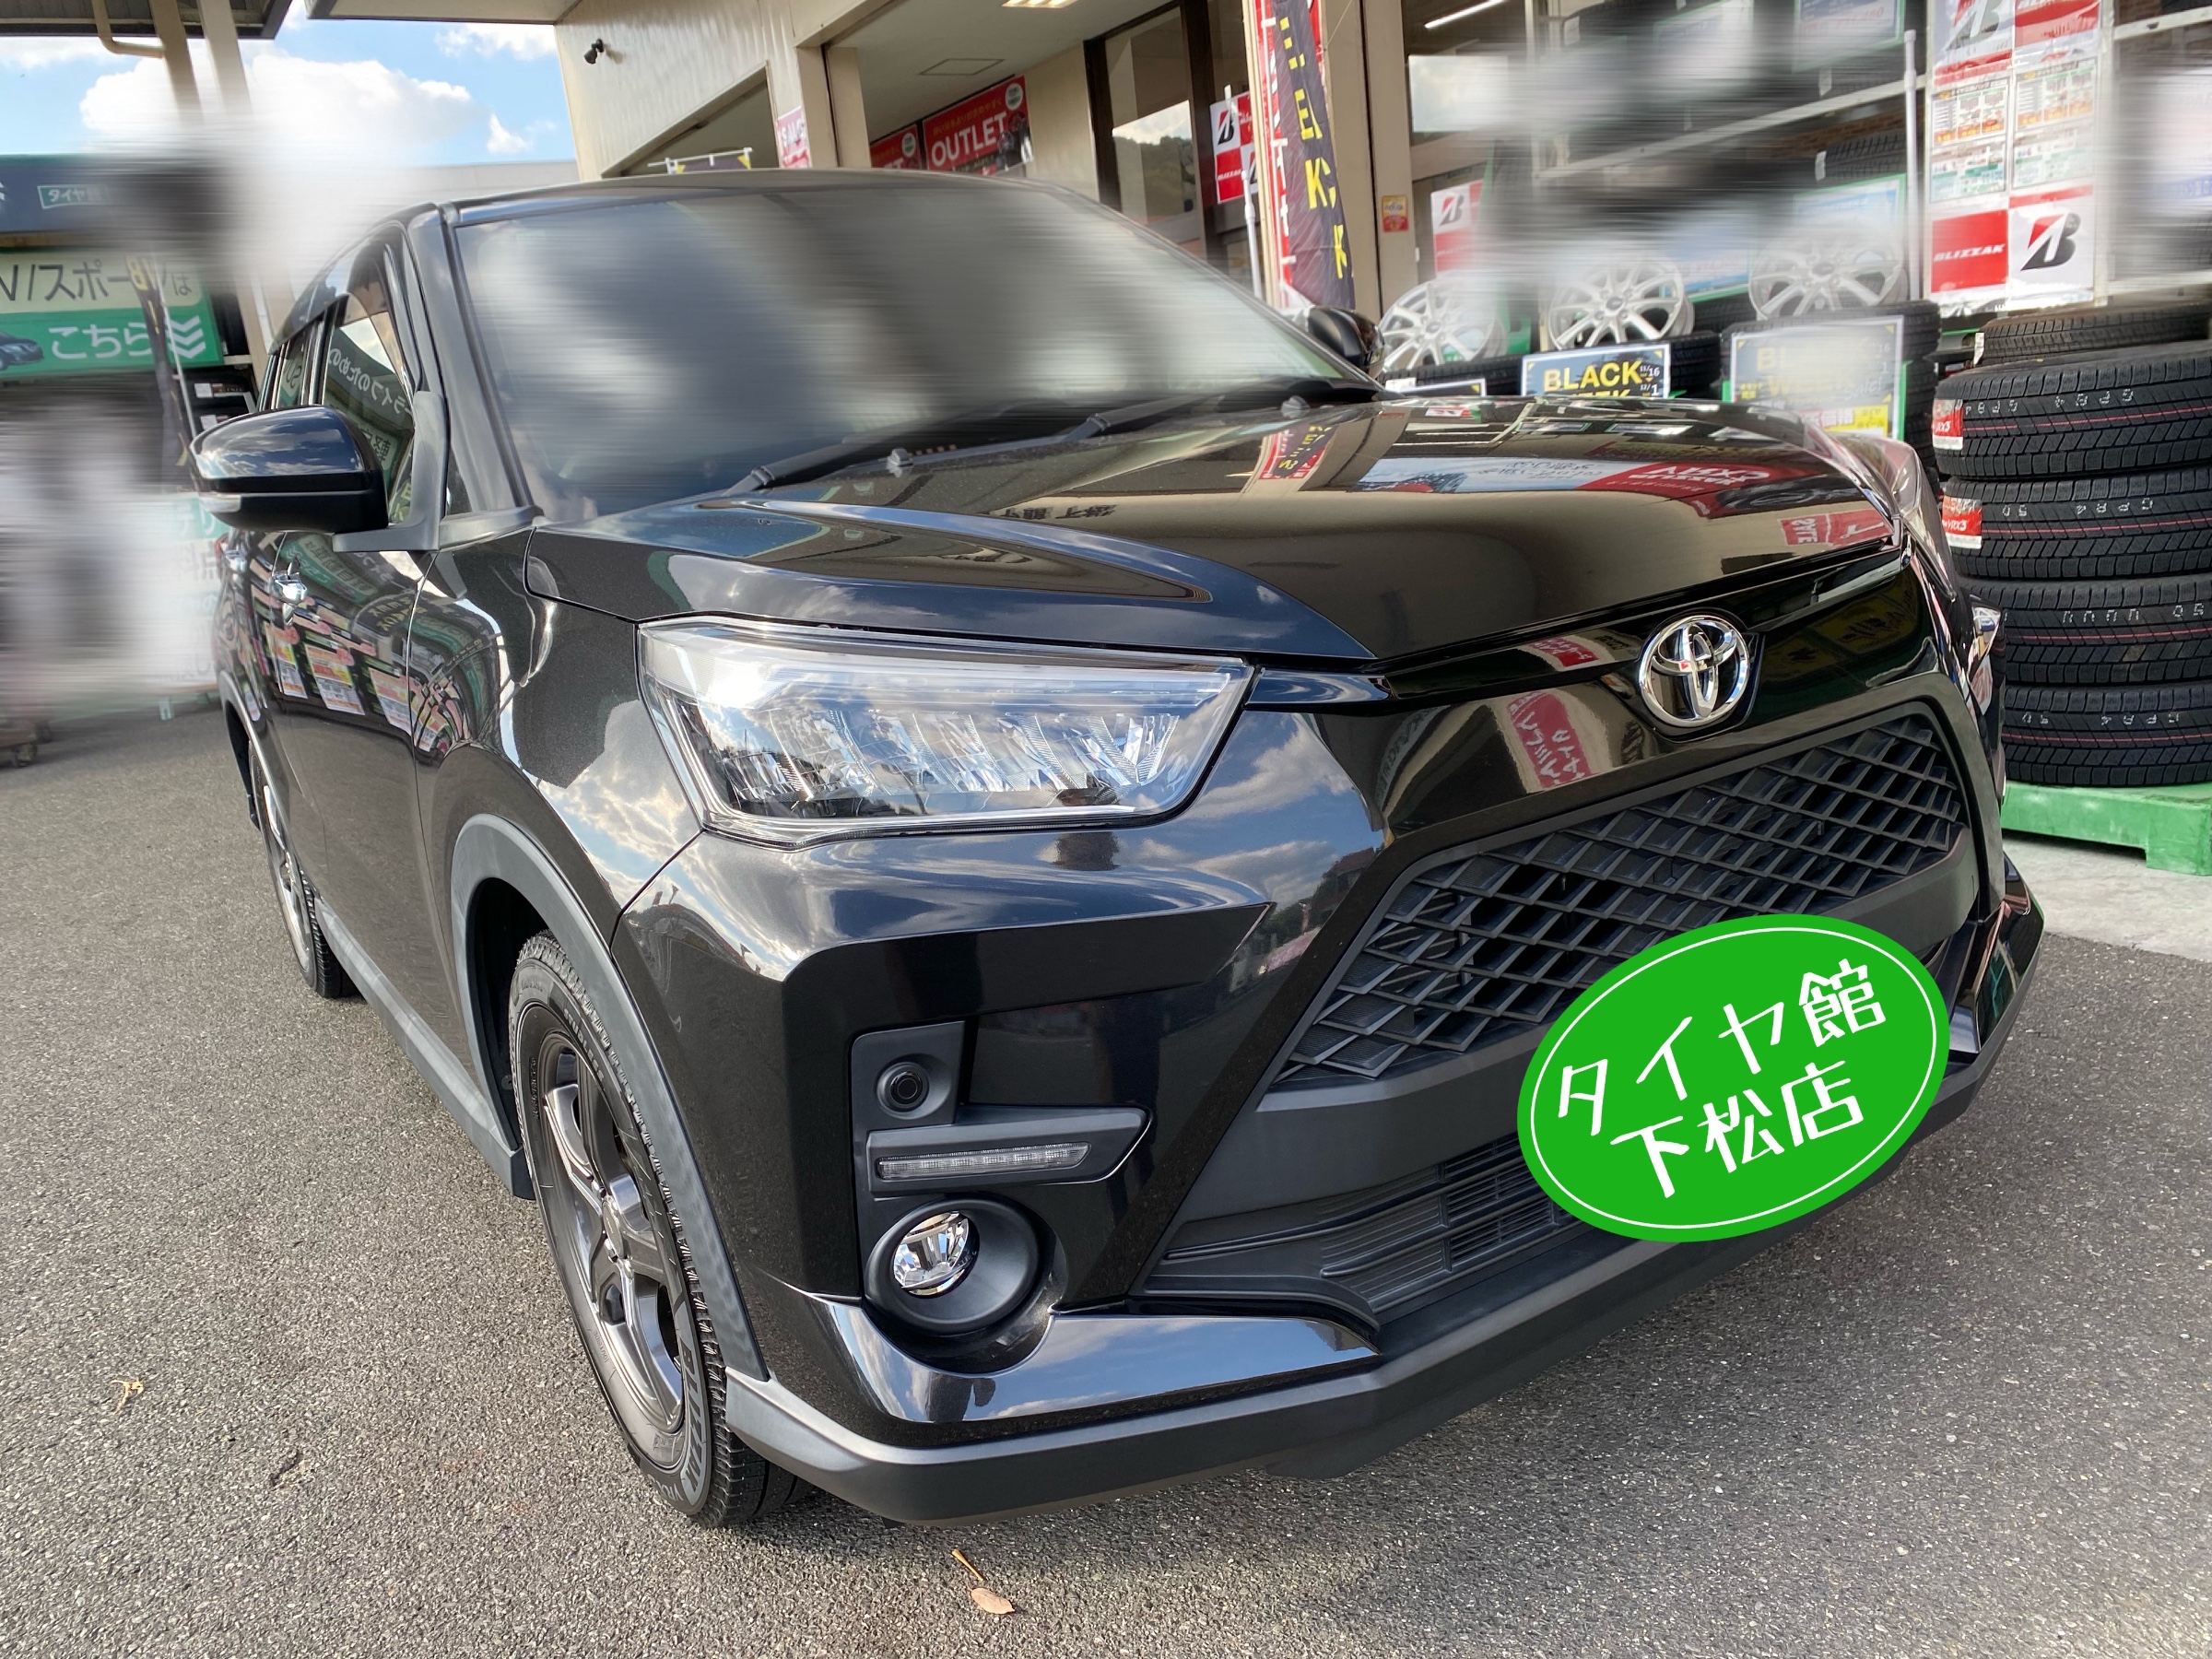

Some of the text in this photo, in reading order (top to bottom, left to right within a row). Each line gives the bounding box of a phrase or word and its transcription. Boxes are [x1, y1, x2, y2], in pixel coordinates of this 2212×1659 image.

[932, 111, 1007, 167] OUTLET
[1934, 243, 2006, 262] BLIZZAK
[49, 323, 151, 359] こちら
[1544, 360, 1643, 392] BLACK
[679, 1335, 704, 1492] BLIZZAK
